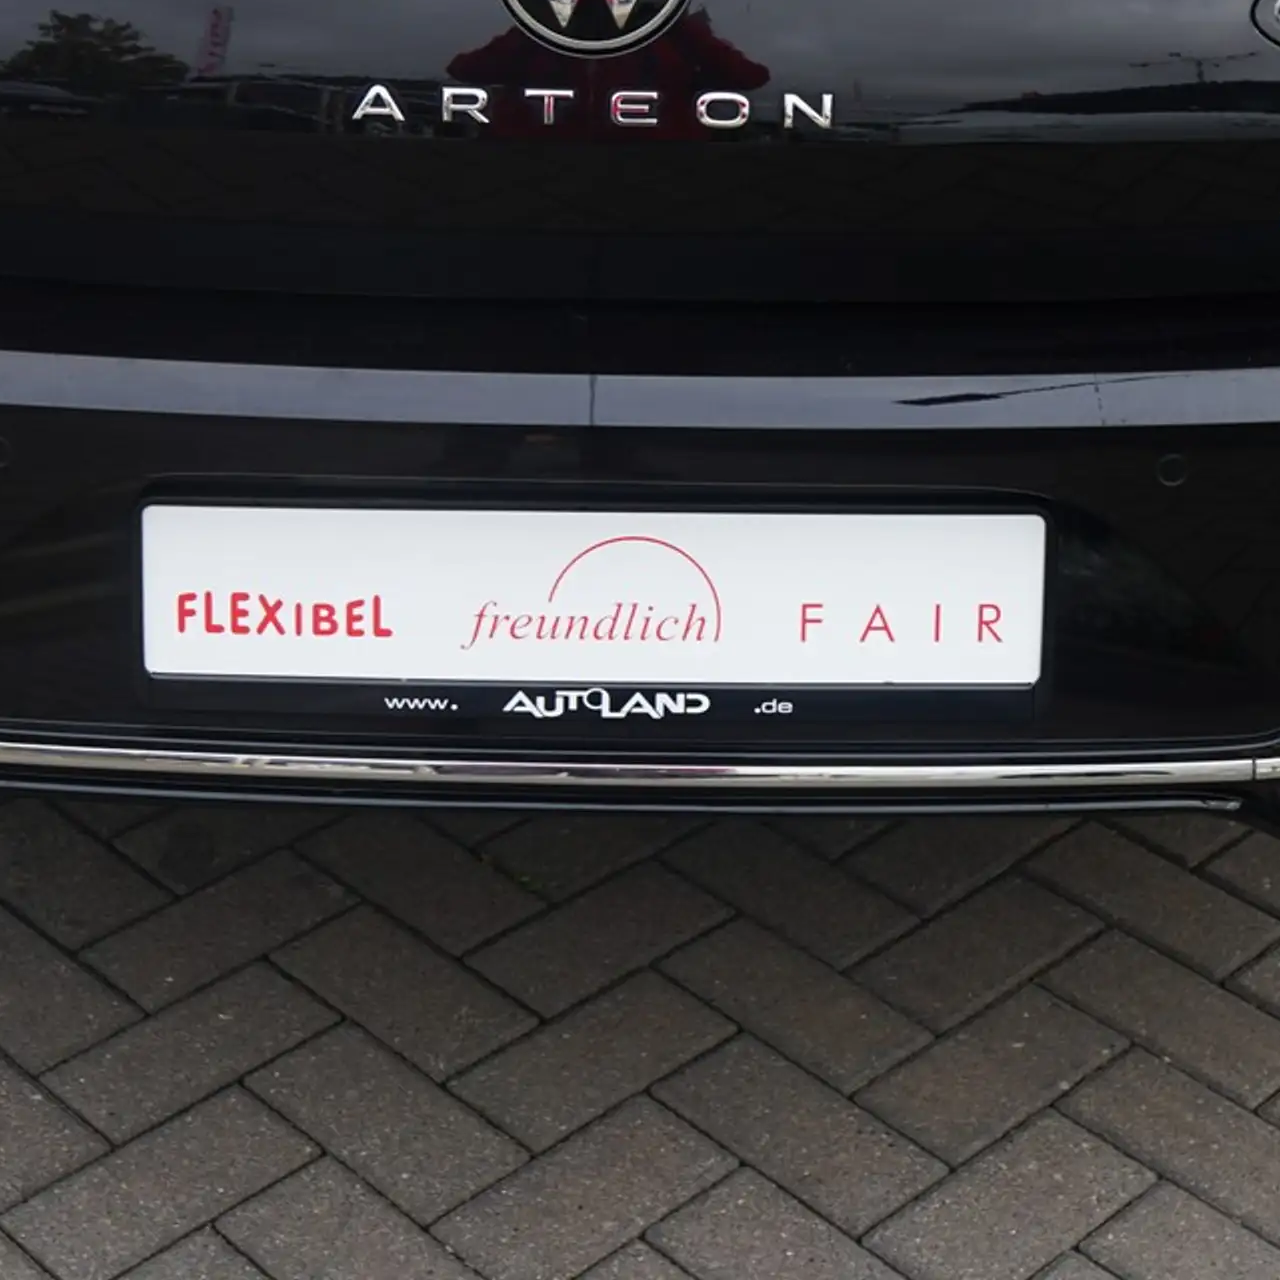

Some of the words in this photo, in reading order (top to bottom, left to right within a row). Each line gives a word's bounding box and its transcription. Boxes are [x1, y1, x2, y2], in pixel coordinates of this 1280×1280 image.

[351, 83, 835, 130] ARTEON
[177, 591, 394, 638] FLEXIBEL
[460, 601, 710, 651] freundlich
[799, 604, 1004, 643] FAIR
[384, 696, 459, 711] www.
[503, 687, 711, 719] AUTOLAND
[754, 699, 793, 714] .de
